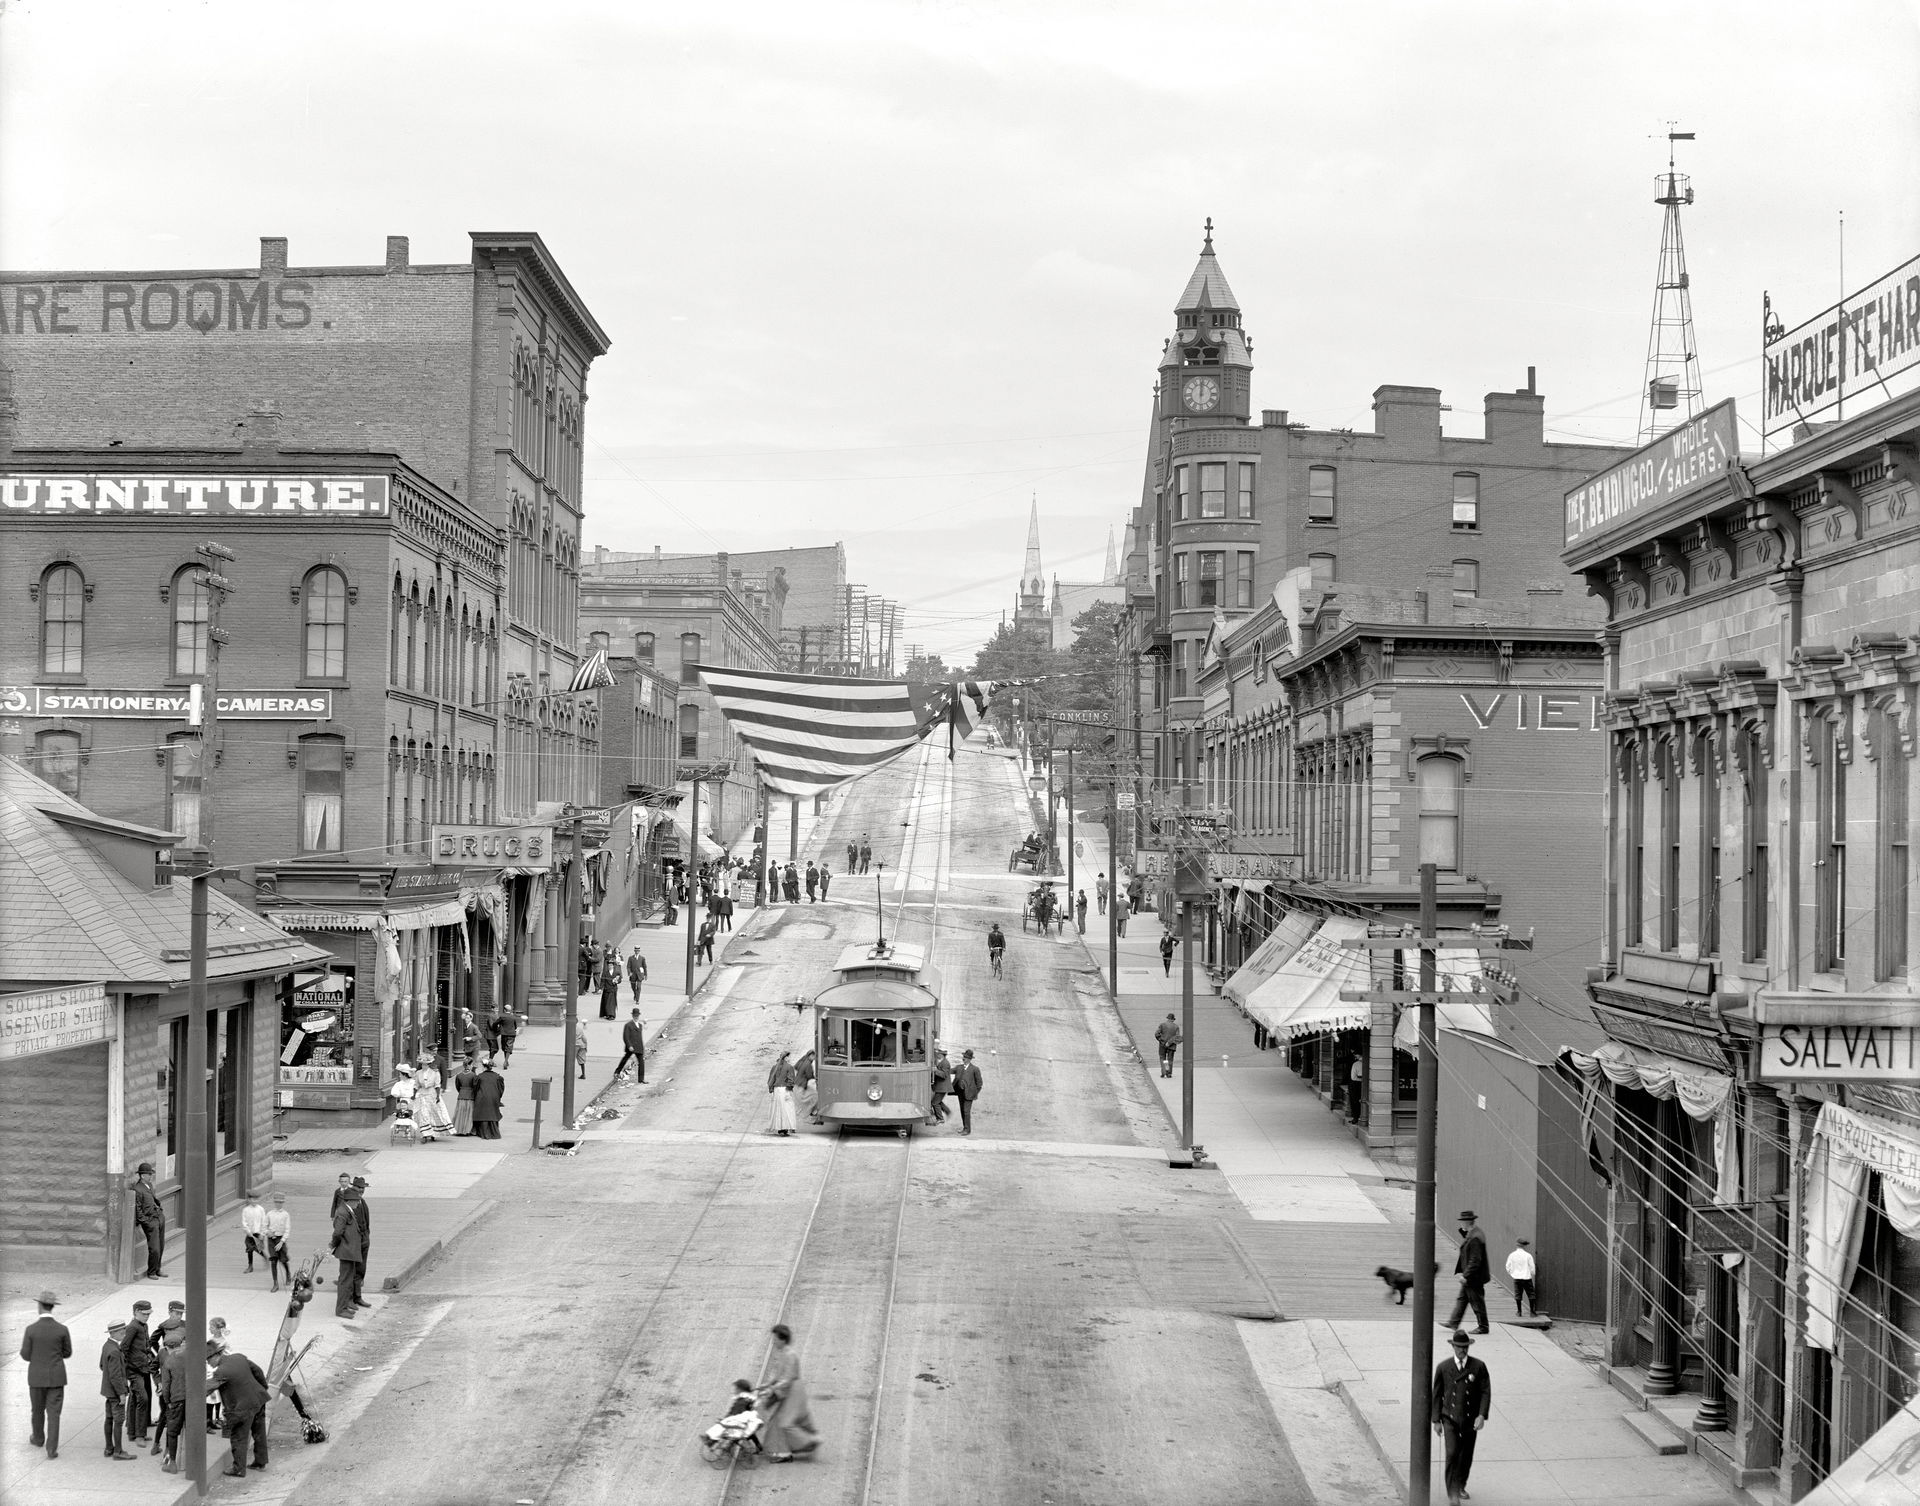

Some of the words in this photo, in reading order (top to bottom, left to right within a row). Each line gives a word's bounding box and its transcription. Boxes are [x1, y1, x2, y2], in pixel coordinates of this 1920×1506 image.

[0, 285, 83, 335] RE
[1673, 418, 1709, 459] WHOLE
[1668, 446, 1722, 493] SALERS.
[1589, 463, 1639, 528] BENDING
[1639, 459, 1658, 500] CO.
[44, 695, 190, 712] STATIONERY
[216, 697, 326, 712] CAMERAS
[440, 834, 543, 858] DRUGS
[1145, 853, 1294, 877] REAURANT
[6, 994, 54, 1015] SOUTH
[60, 986, 105, 1007] SHORE
[296, 992, 343, 1001] NATIONAL
[73, 1003, 117, 1026] STATION
[15, 1036, 49, 1055] PRIVATE
[55, 1028, 93, 1047] PROPERTY
